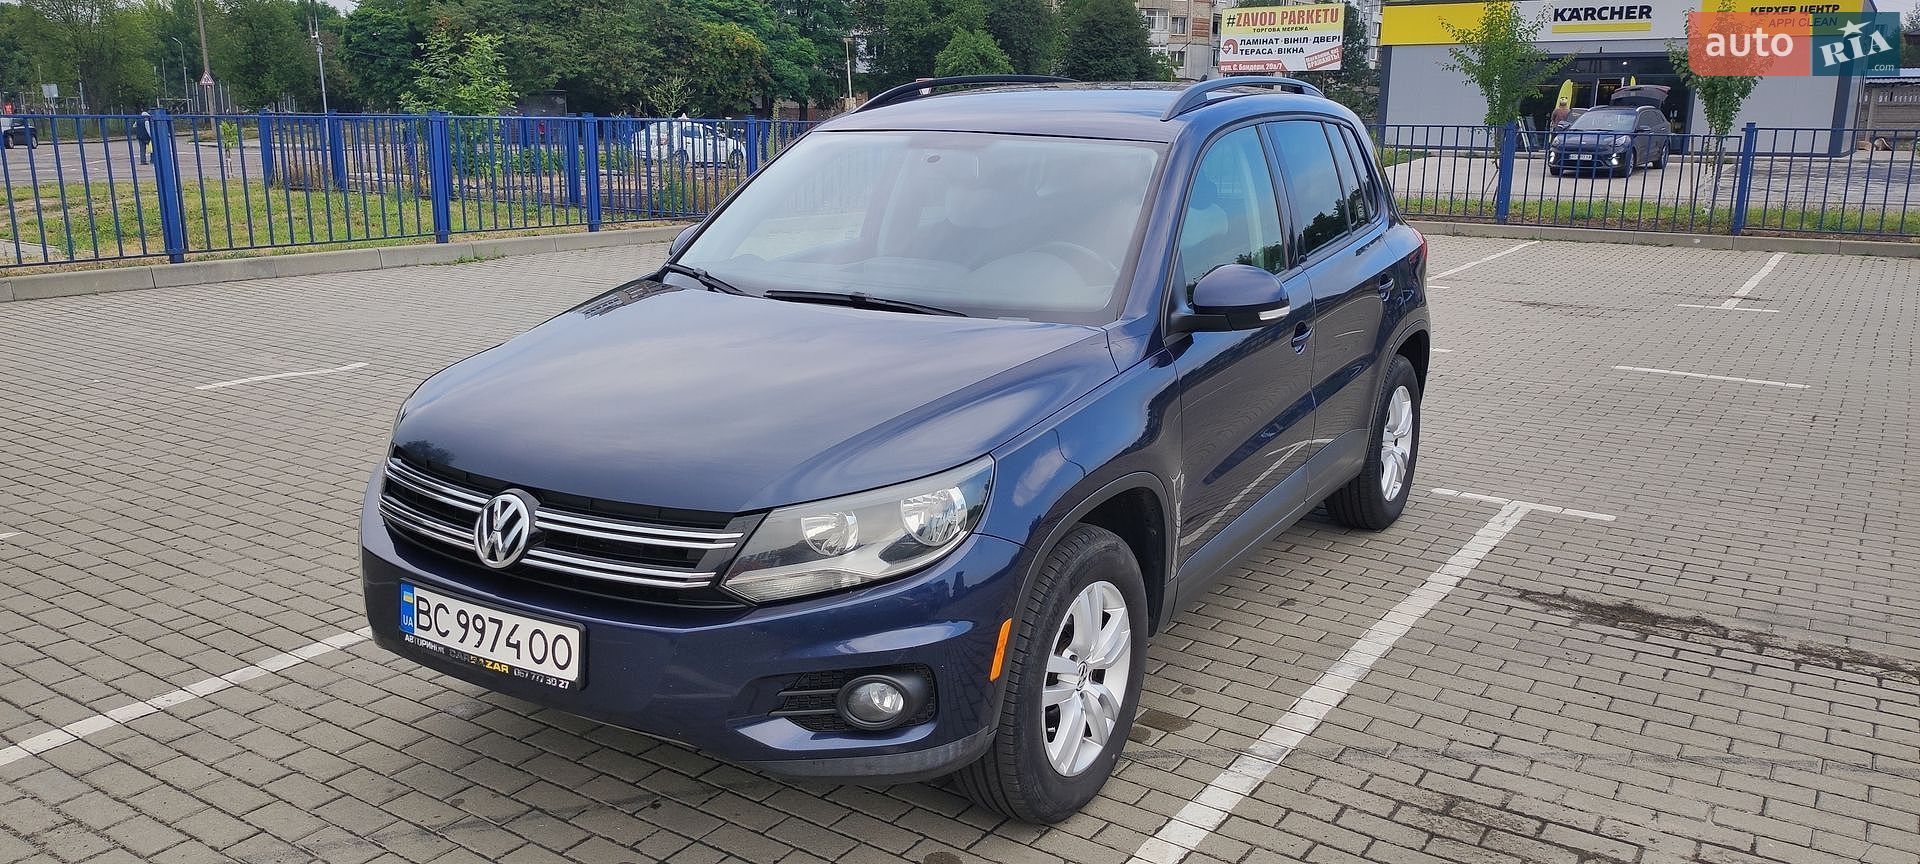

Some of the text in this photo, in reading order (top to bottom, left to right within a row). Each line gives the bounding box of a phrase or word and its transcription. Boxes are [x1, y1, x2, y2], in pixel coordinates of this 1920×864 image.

[1553, 5, 1652, 21] KÄRCHER
[1750, 4, 1840, 15] КЕРХЕР ЦЕНТР
[1227, 8, 1339, 27] #ZAVOD PARKETU
[1799, 17, 1838, 27] CLEAN
[1240, 35, 1341, 45] ЛАМІНАТ ВІНІЛ ДВЕРІ
[402, 614, 413, 628] UA
[456, 609, 521, 660] 9974
[559, 679, 569, 689] 27
